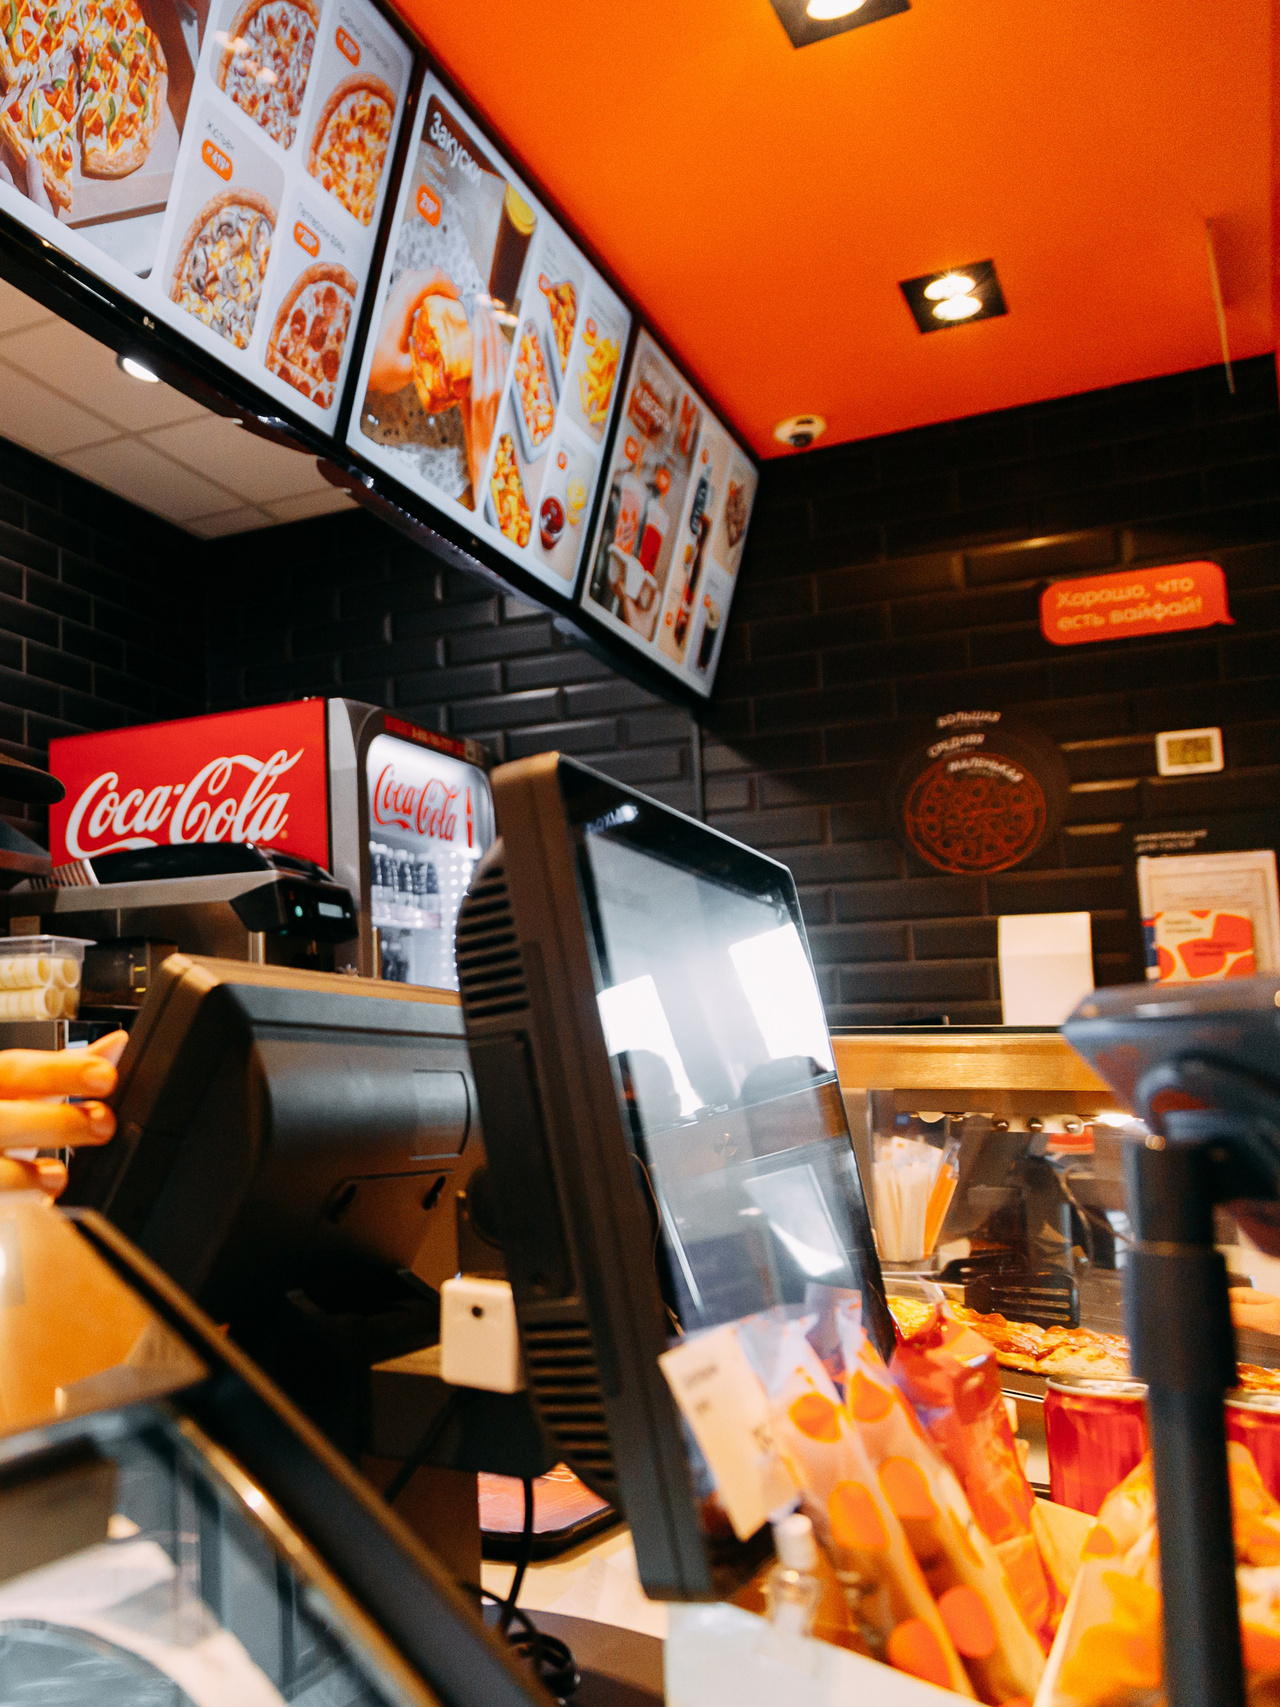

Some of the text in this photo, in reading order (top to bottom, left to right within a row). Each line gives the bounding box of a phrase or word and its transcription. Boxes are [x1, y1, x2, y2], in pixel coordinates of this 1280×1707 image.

[429, 111, 483, 187] Закуски
[1057, 613, 1105, 631] есть
[1155, 577, 1195, 593] что
[65, 748, 305, 860] Coca-Cola
[373, 763, 460, 842] Coca-Cola
